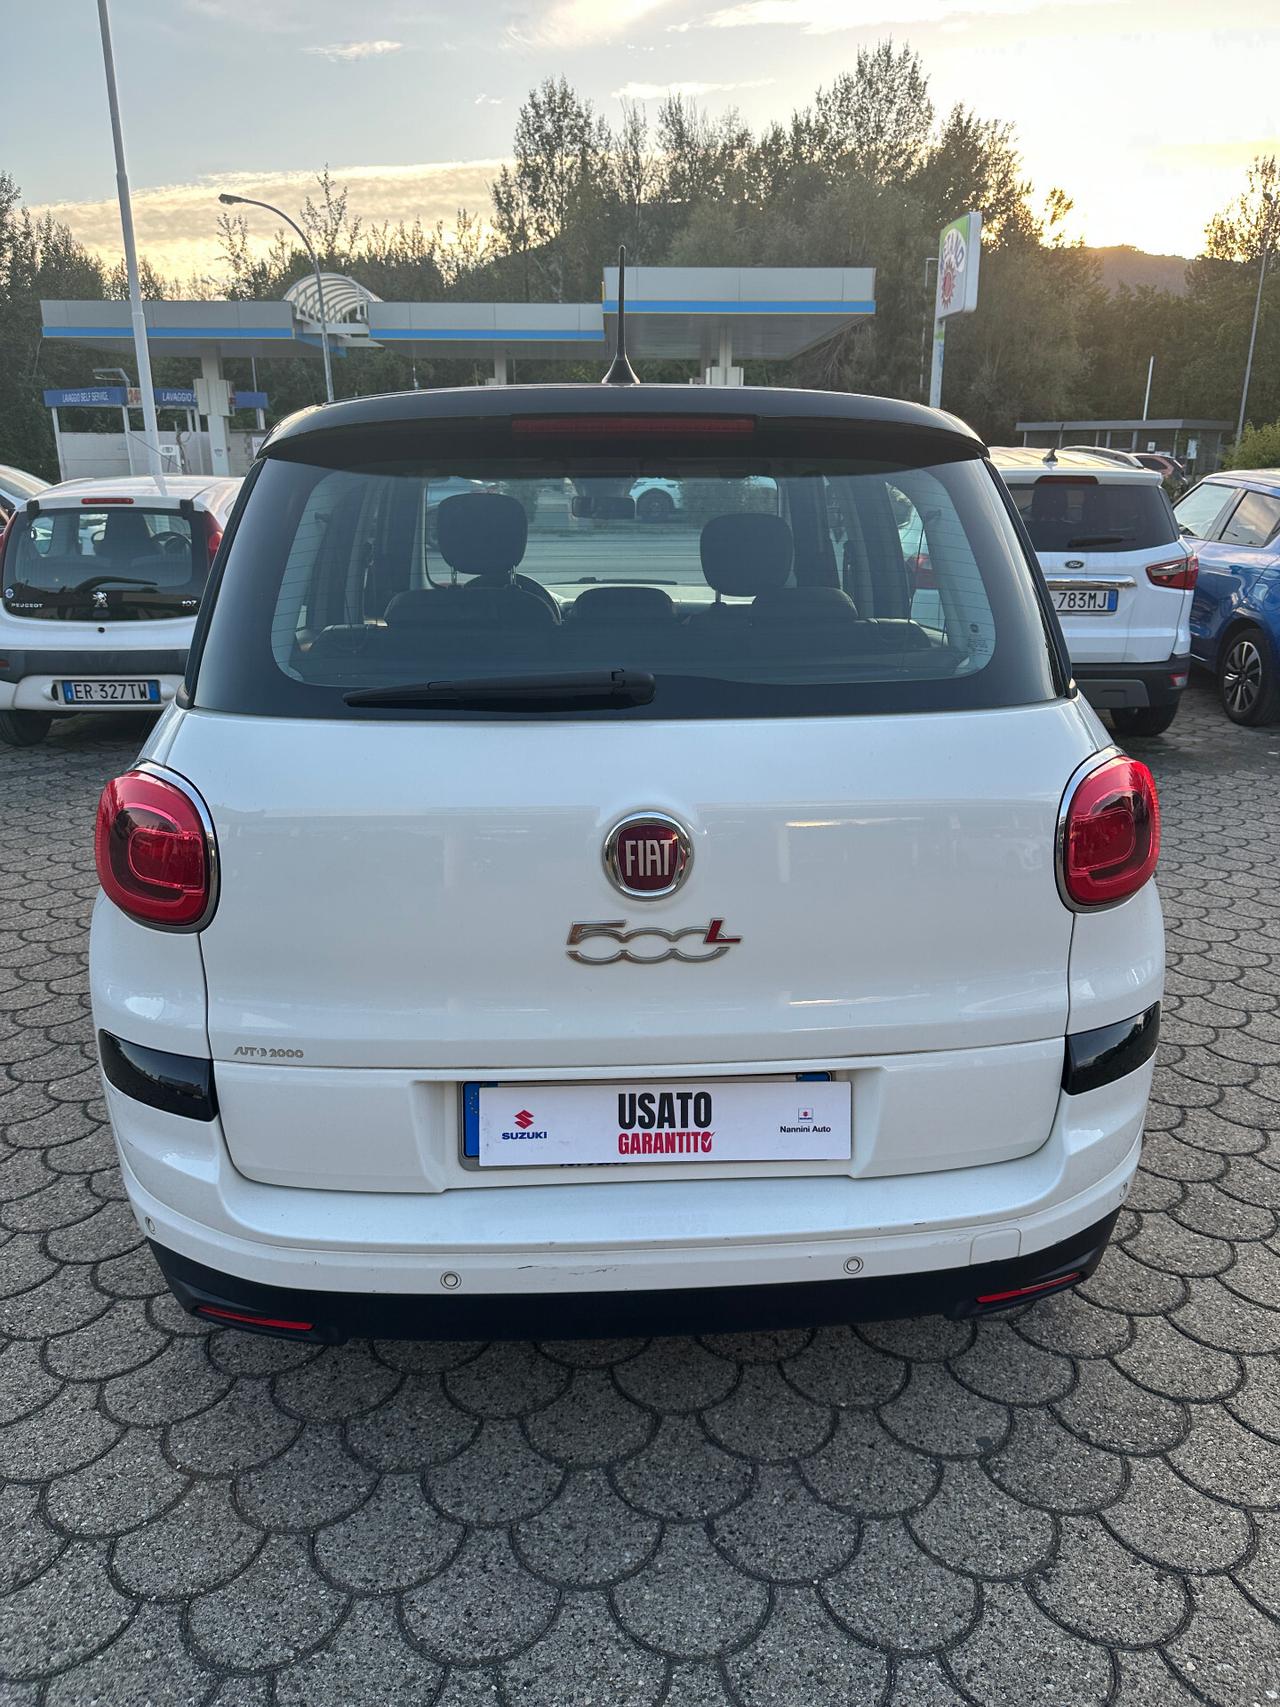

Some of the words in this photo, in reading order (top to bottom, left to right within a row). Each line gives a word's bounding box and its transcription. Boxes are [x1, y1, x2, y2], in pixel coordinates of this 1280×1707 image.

[162, 391, 192, 402] LAVAGGIO
[1057, 592, 1107, 609] 783MJ
[625, 839, 673, 877] FIAT
[565, 917, 743, 966] 500L
[268, 1048, 304, 1058] 2000
[618, 1091, 712, 1130] USATO
[501, 1131, 548, 1140] SUZUKI
[780, 1125, 811, 1133] Nannini
[811, 1125, 831, 1133] Auto
[618, 1131, 715, 1155] GARANTITO
